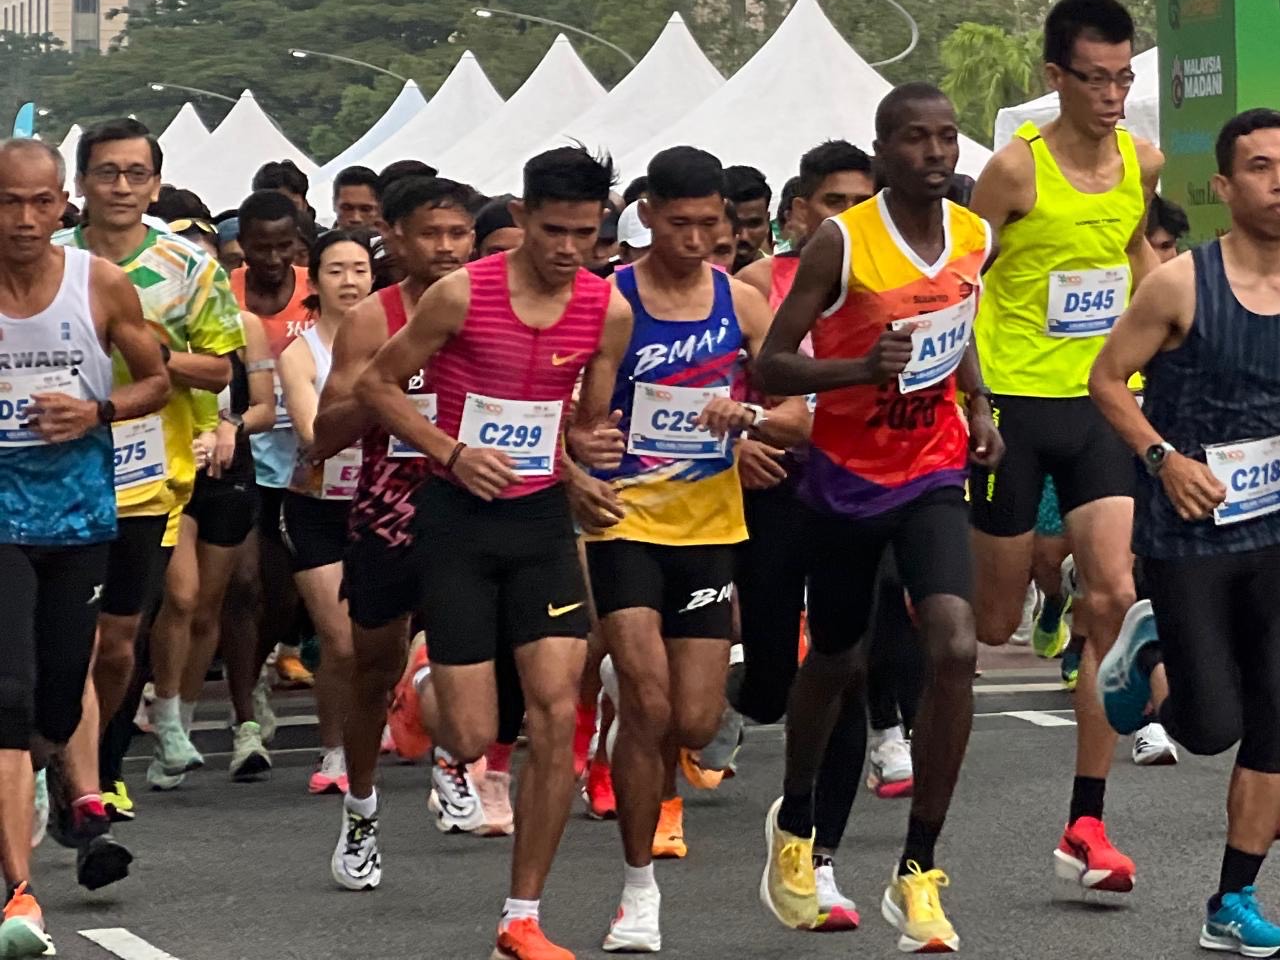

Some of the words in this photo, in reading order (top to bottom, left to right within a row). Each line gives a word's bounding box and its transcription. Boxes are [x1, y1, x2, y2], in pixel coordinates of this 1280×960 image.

[1183, 55, 1222, 76] MALAYSIA
[1184, 73, 1223, 98] MADANI
[1064, 289, 1115, 313] D545
[918, 321, 966, 361] A114
[479, 422, 543, 448] C299
[1230, 459, 1280, 492] C218
